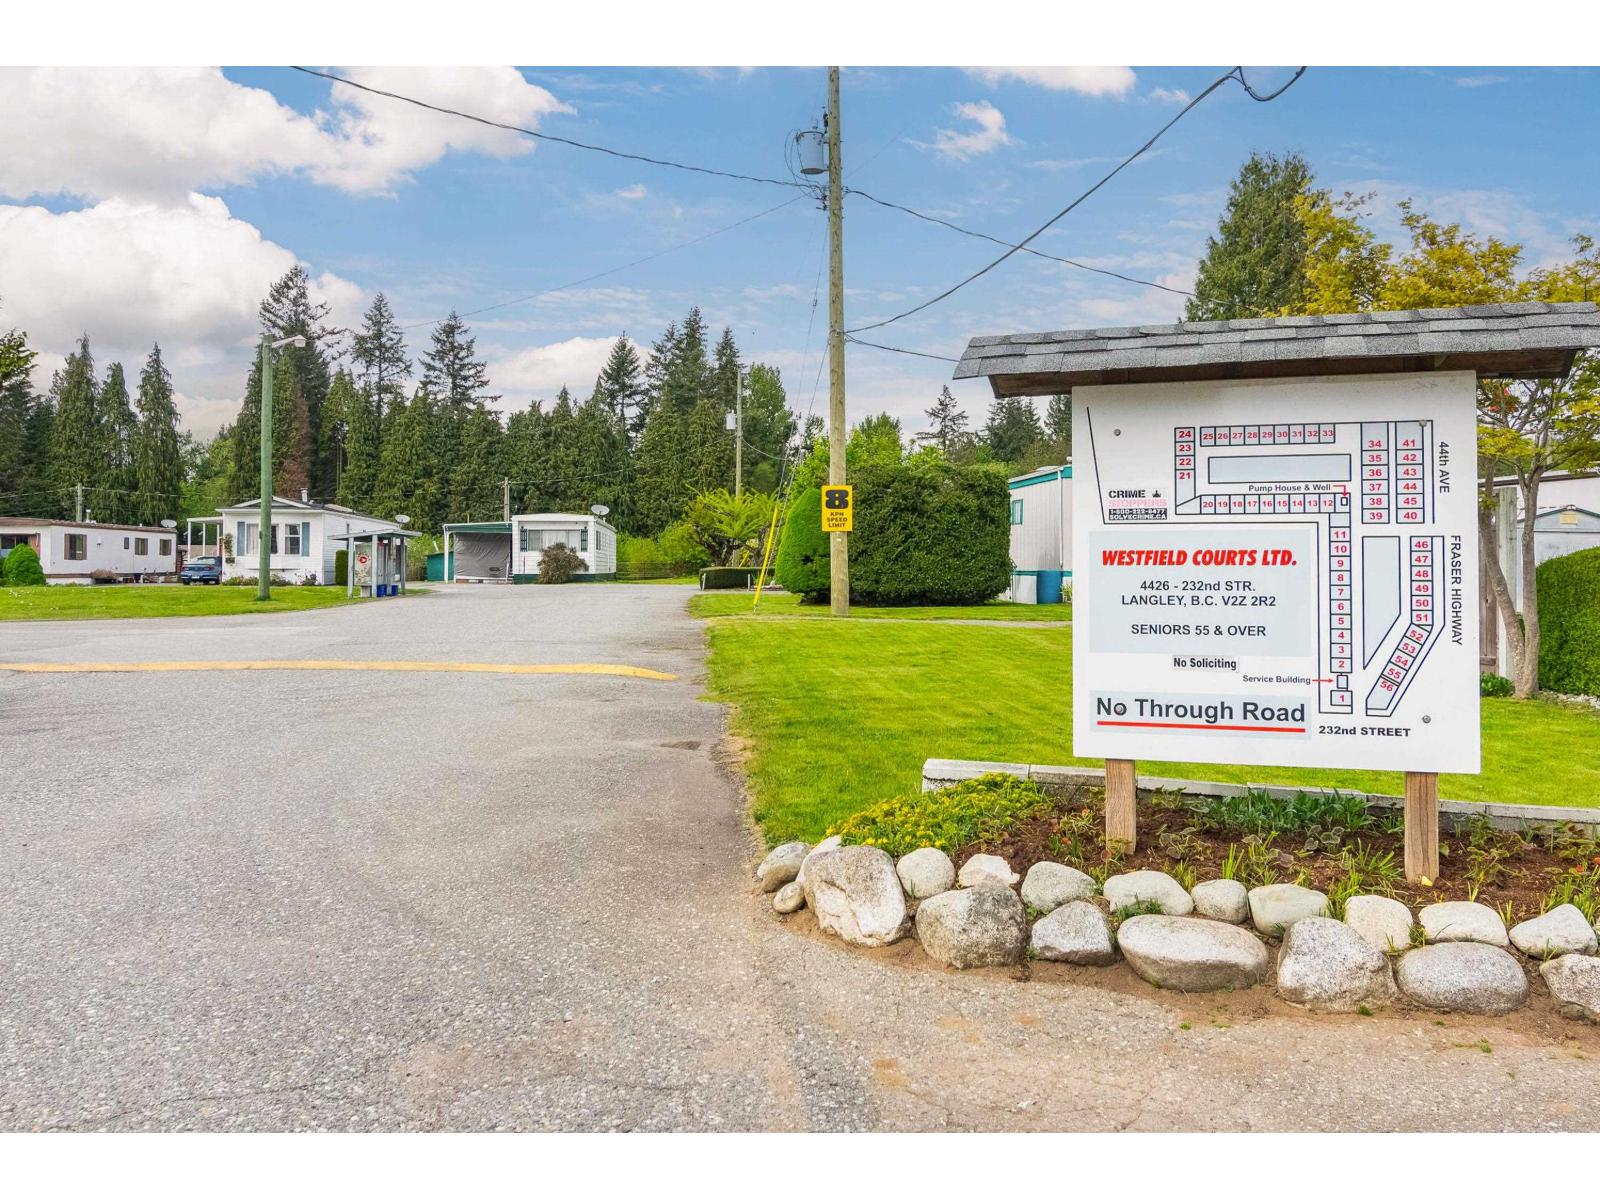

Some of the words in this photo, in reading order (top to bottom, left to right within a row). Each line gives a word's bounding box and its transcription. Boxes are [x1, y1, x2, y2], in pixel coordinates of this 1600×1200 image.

[1179, 430, 1191, 438] 24
[1368, 440, 1381, 448] 34
[1439, 442, 1449, 466] 44th
[1369, 469, 1382, 477] 36
[1369, 483, 1382, 491] 37
[1440, 470, 1449, 493] AVE
[826, 490, 848, 509] 8
[1109, 490, 1145, 498] CRIME
[1370, 512, 1382, 520] 39
[1334, 531, 1346, 539] 11
[1334, 545, 1347, 553] 10
[1102, 550, 1187, 566] WESTFIELD
[1192, 549, 1257, 566] COURTS
[1261, 549, 1297, 566] LTD.
[1451, 536, 1461, 585] FRASER
[1337, 574, 1344, 582] 8
[1140, 581, 1169, 591] 4426
[1182, 581, 1220, 591] 232nd
[1225, 581, 1255, 591] STR.
[1122, 595, 1186, 607] LANGLEY,
[1191, 596, 1217, 606] B.C.
[1222, 596, 1247, 606] V2Z
[1251, 596, 1276, 606] 2R2
[1338, 603, 1344, 611] 6
[1452, 589, 1462, 645] HIGHWAY
[1131, 624, 1190, 635] SENIORS
[1195, 625, 1209, 635] 55
[1214, 626, 1223, 636] &
[1228, 626, 1266, 636] OVER
[1410, 630, 1423, 641] 52
[1338, 646, 1345, 654] 3
[1402, 643, 1415, 654] 53
[1174, 658, 1187, 668] No
[1190, 658, 1237, 670] Soliciting
[1395, 656, 1408, 667] 54
[1388, 668, 1401, 679] 55
[1243, 675, 1273, 683] Service
[1276, 676, 1311, 685] Building
[1380, 681, 1393, 691] 56
[1097, 697, 1127, 716] No
[1135, 699, 1233, 724] Through
[1243, 702, 1305, 722] Road
[1319, 726, 1356, 735] 232nd
[1361, 728, 1411, 737] STREET
